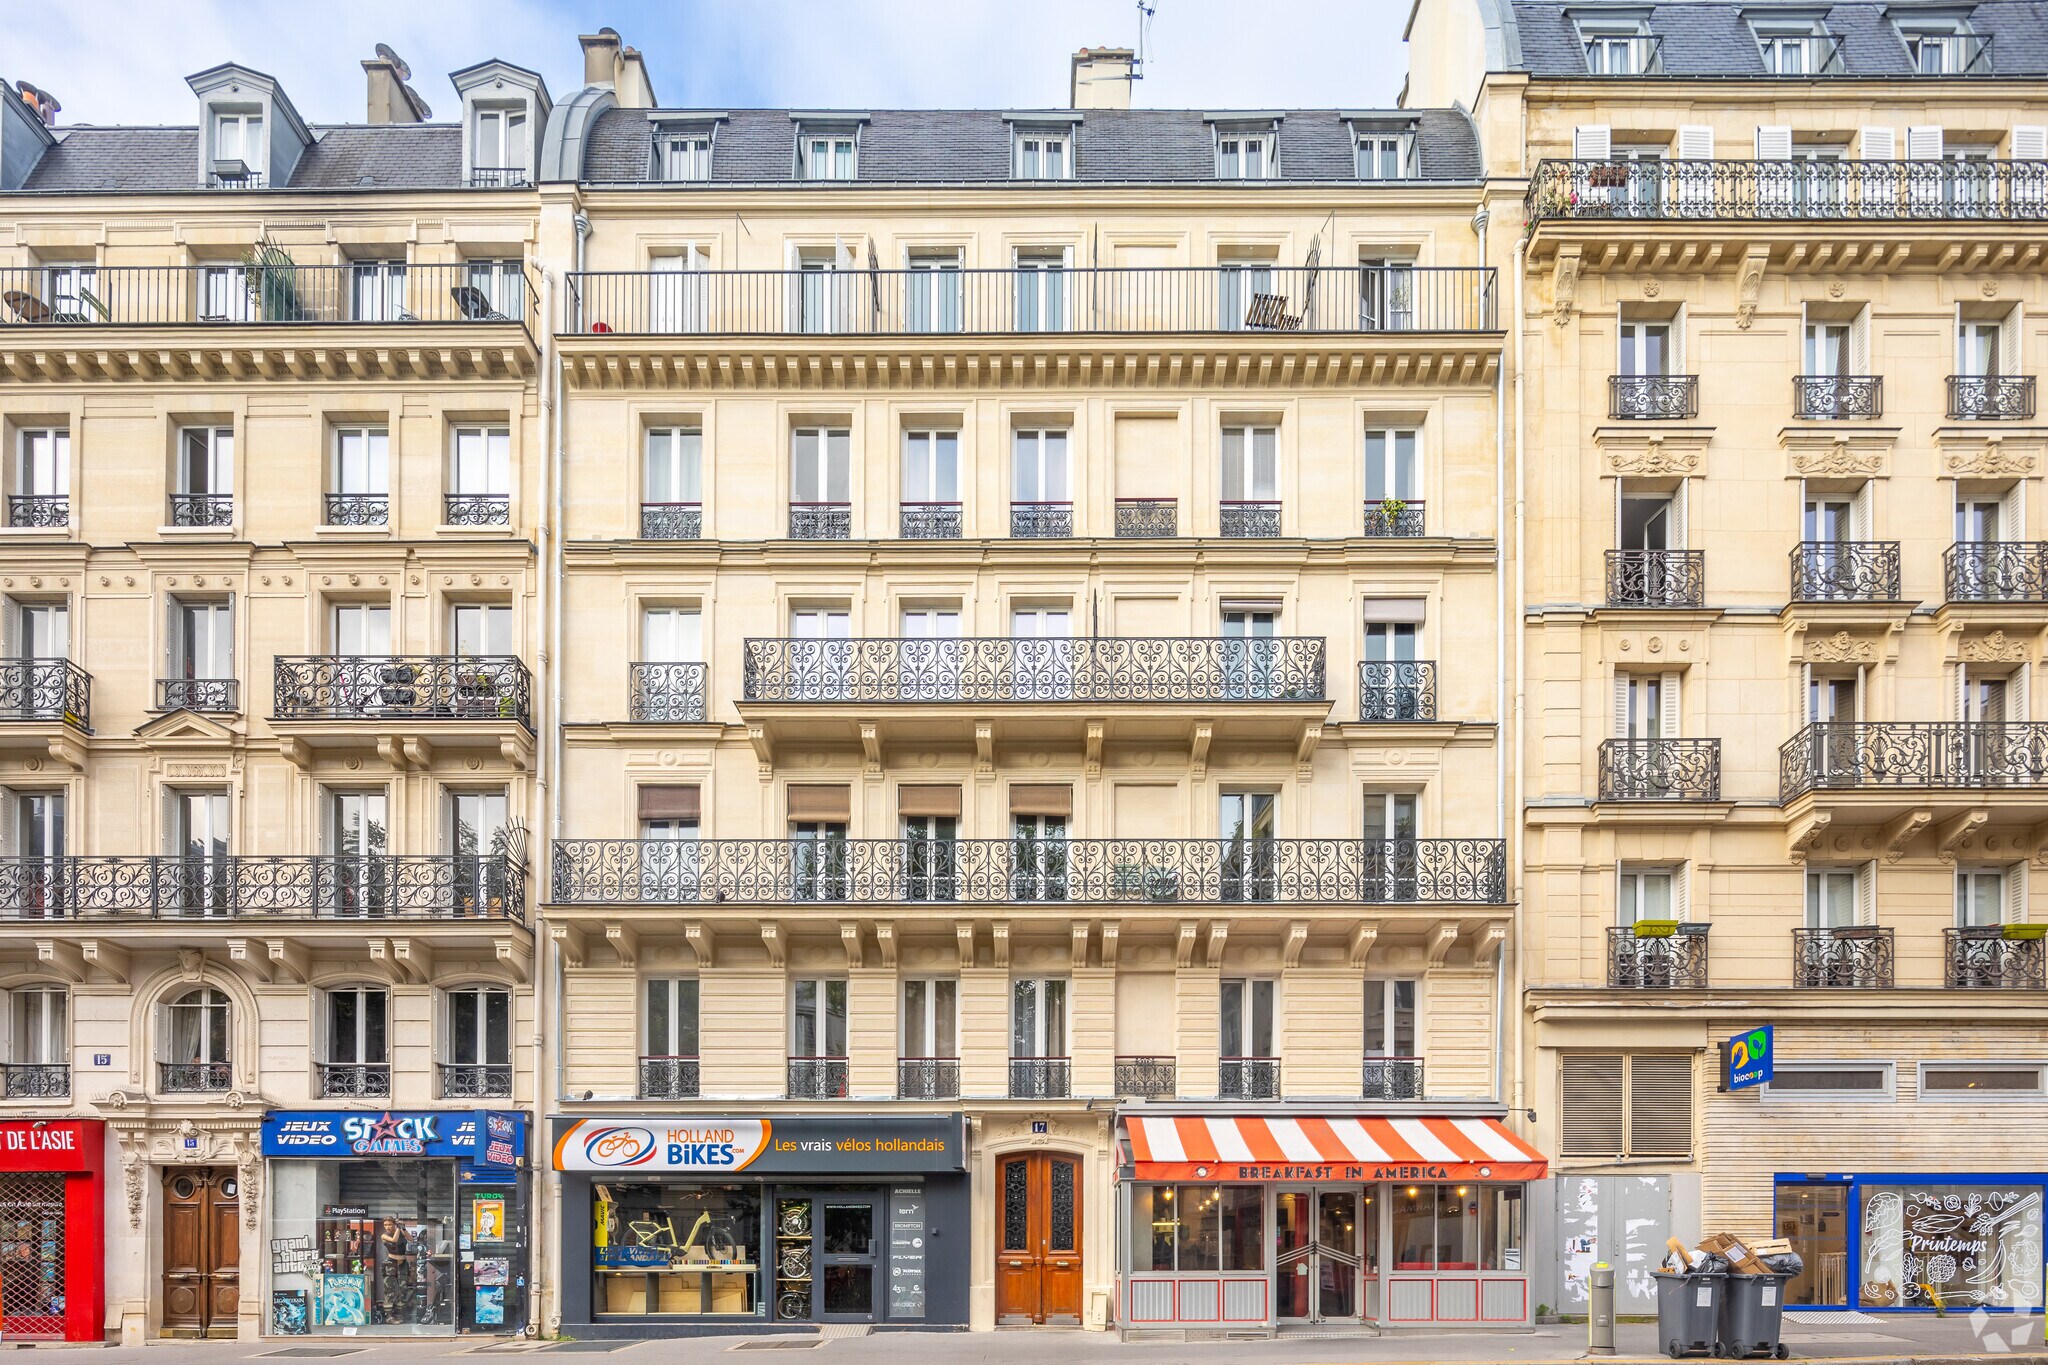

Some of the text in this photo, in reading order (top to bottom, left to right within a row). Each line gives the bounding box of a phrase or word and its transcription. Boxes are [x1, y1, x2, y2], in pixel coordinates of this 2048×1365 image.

[96, 1054, 108, 1065] 15
[1734, 1069, 1763, 1083] biocoop
[280, 1121, 333, 1132] JEUX
[456, 1121, 475, 1132] JE
[1034, 1122, 1046, 1133] 17
[7, 1131, 27, 1150] DE
[30, 1130, 75, 1150] L'ASIE
[186, 1139, 195, 1147] 15
[667, 1129, 734, 1143] HOLLAND
[353, 1138, 424, 1154] GAMES
[489, 1140, 513, 1154] JEUX
[775, 1137, 945, 1151] Les vrais vélos hollandais
[1239, 1166, 1448, 1179] BREAKFAST IN AMERICA
[1911, 1235, 1988, 1256] Printemps
